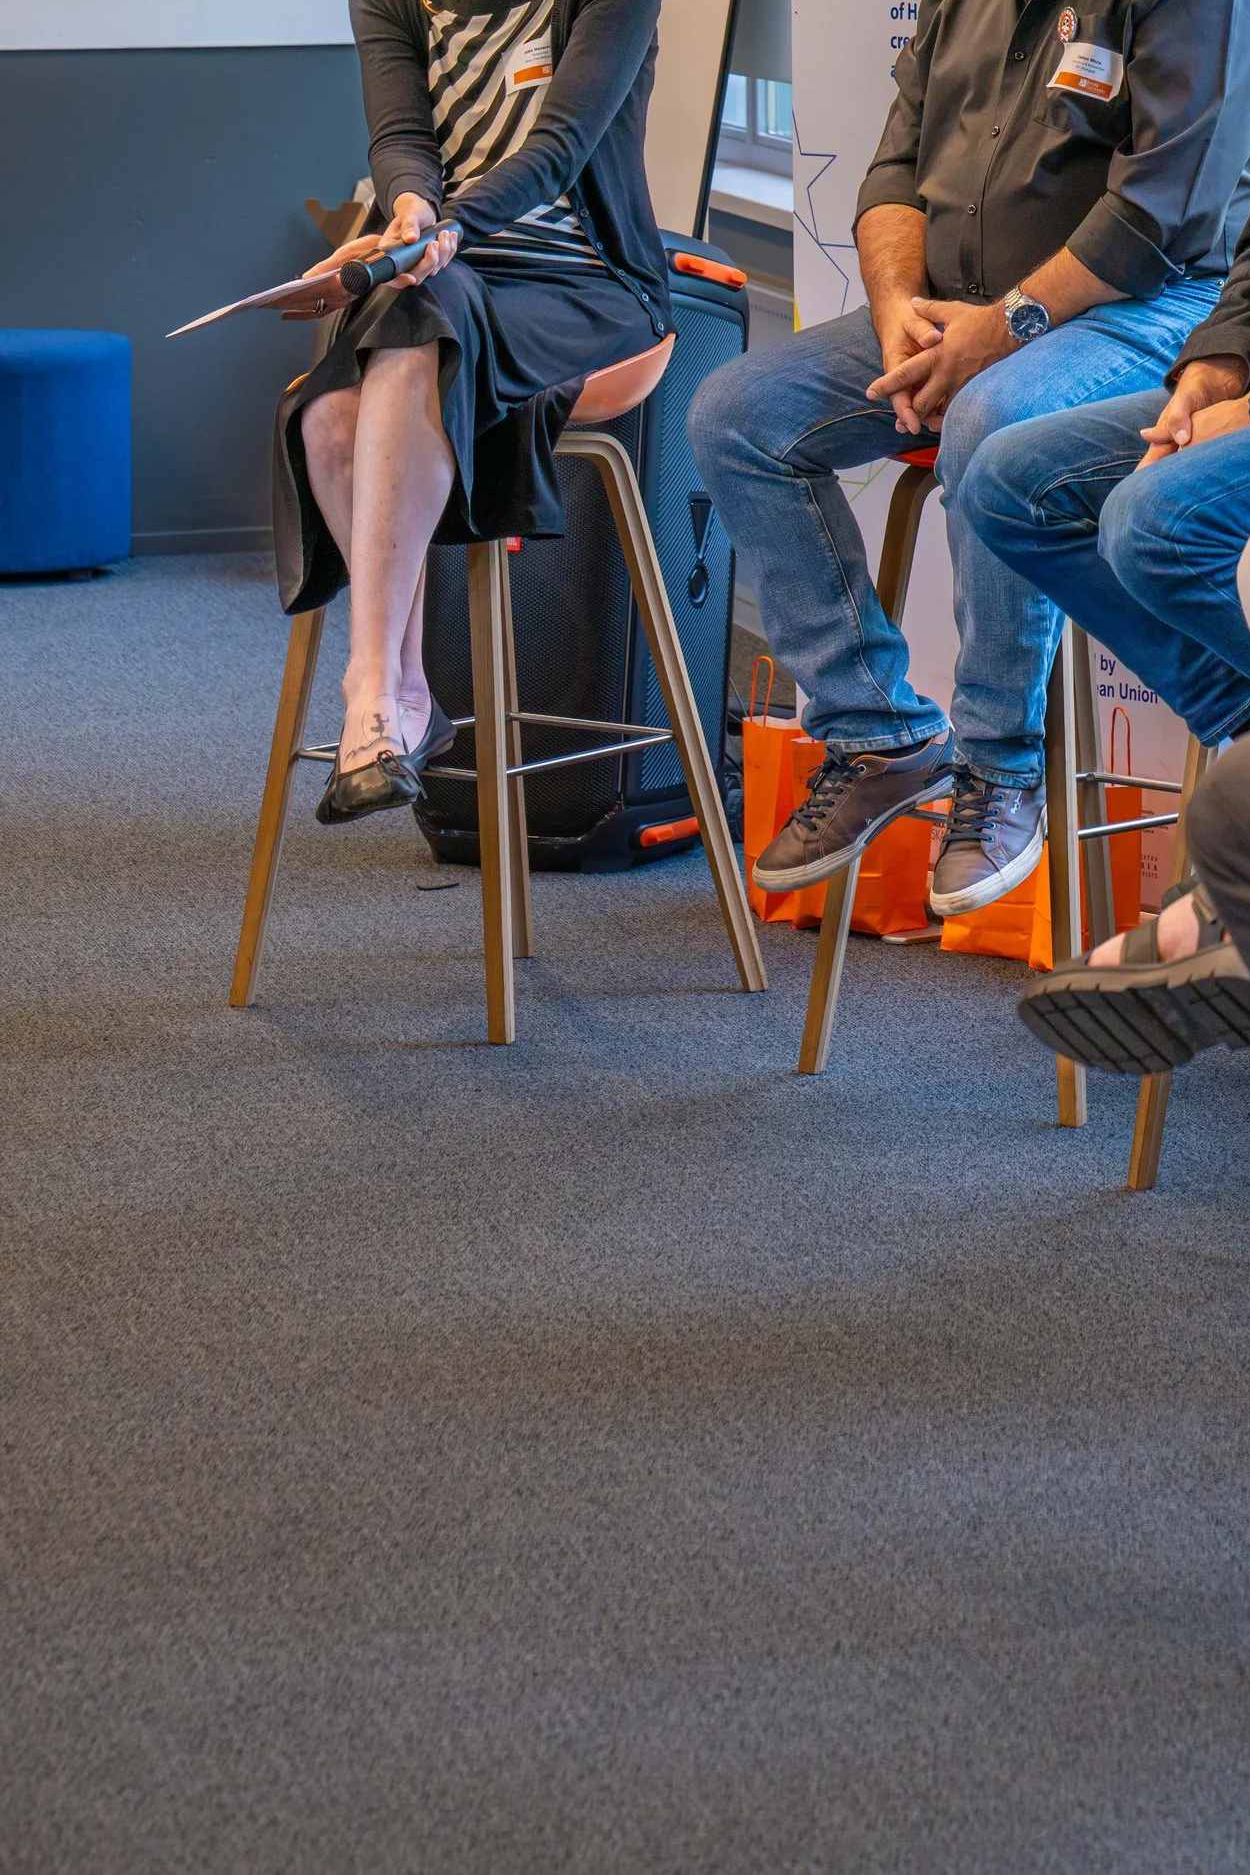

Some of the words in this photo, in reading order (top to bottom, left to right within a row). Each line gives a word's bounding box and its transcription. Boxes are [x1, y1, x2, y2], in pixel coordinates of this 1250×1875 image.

[890, 2, 905, 20] of
[908, 3, 917, 20] H
[1100, 654, 1116, 676] by
[1119, 682, 1158, 704] Union
